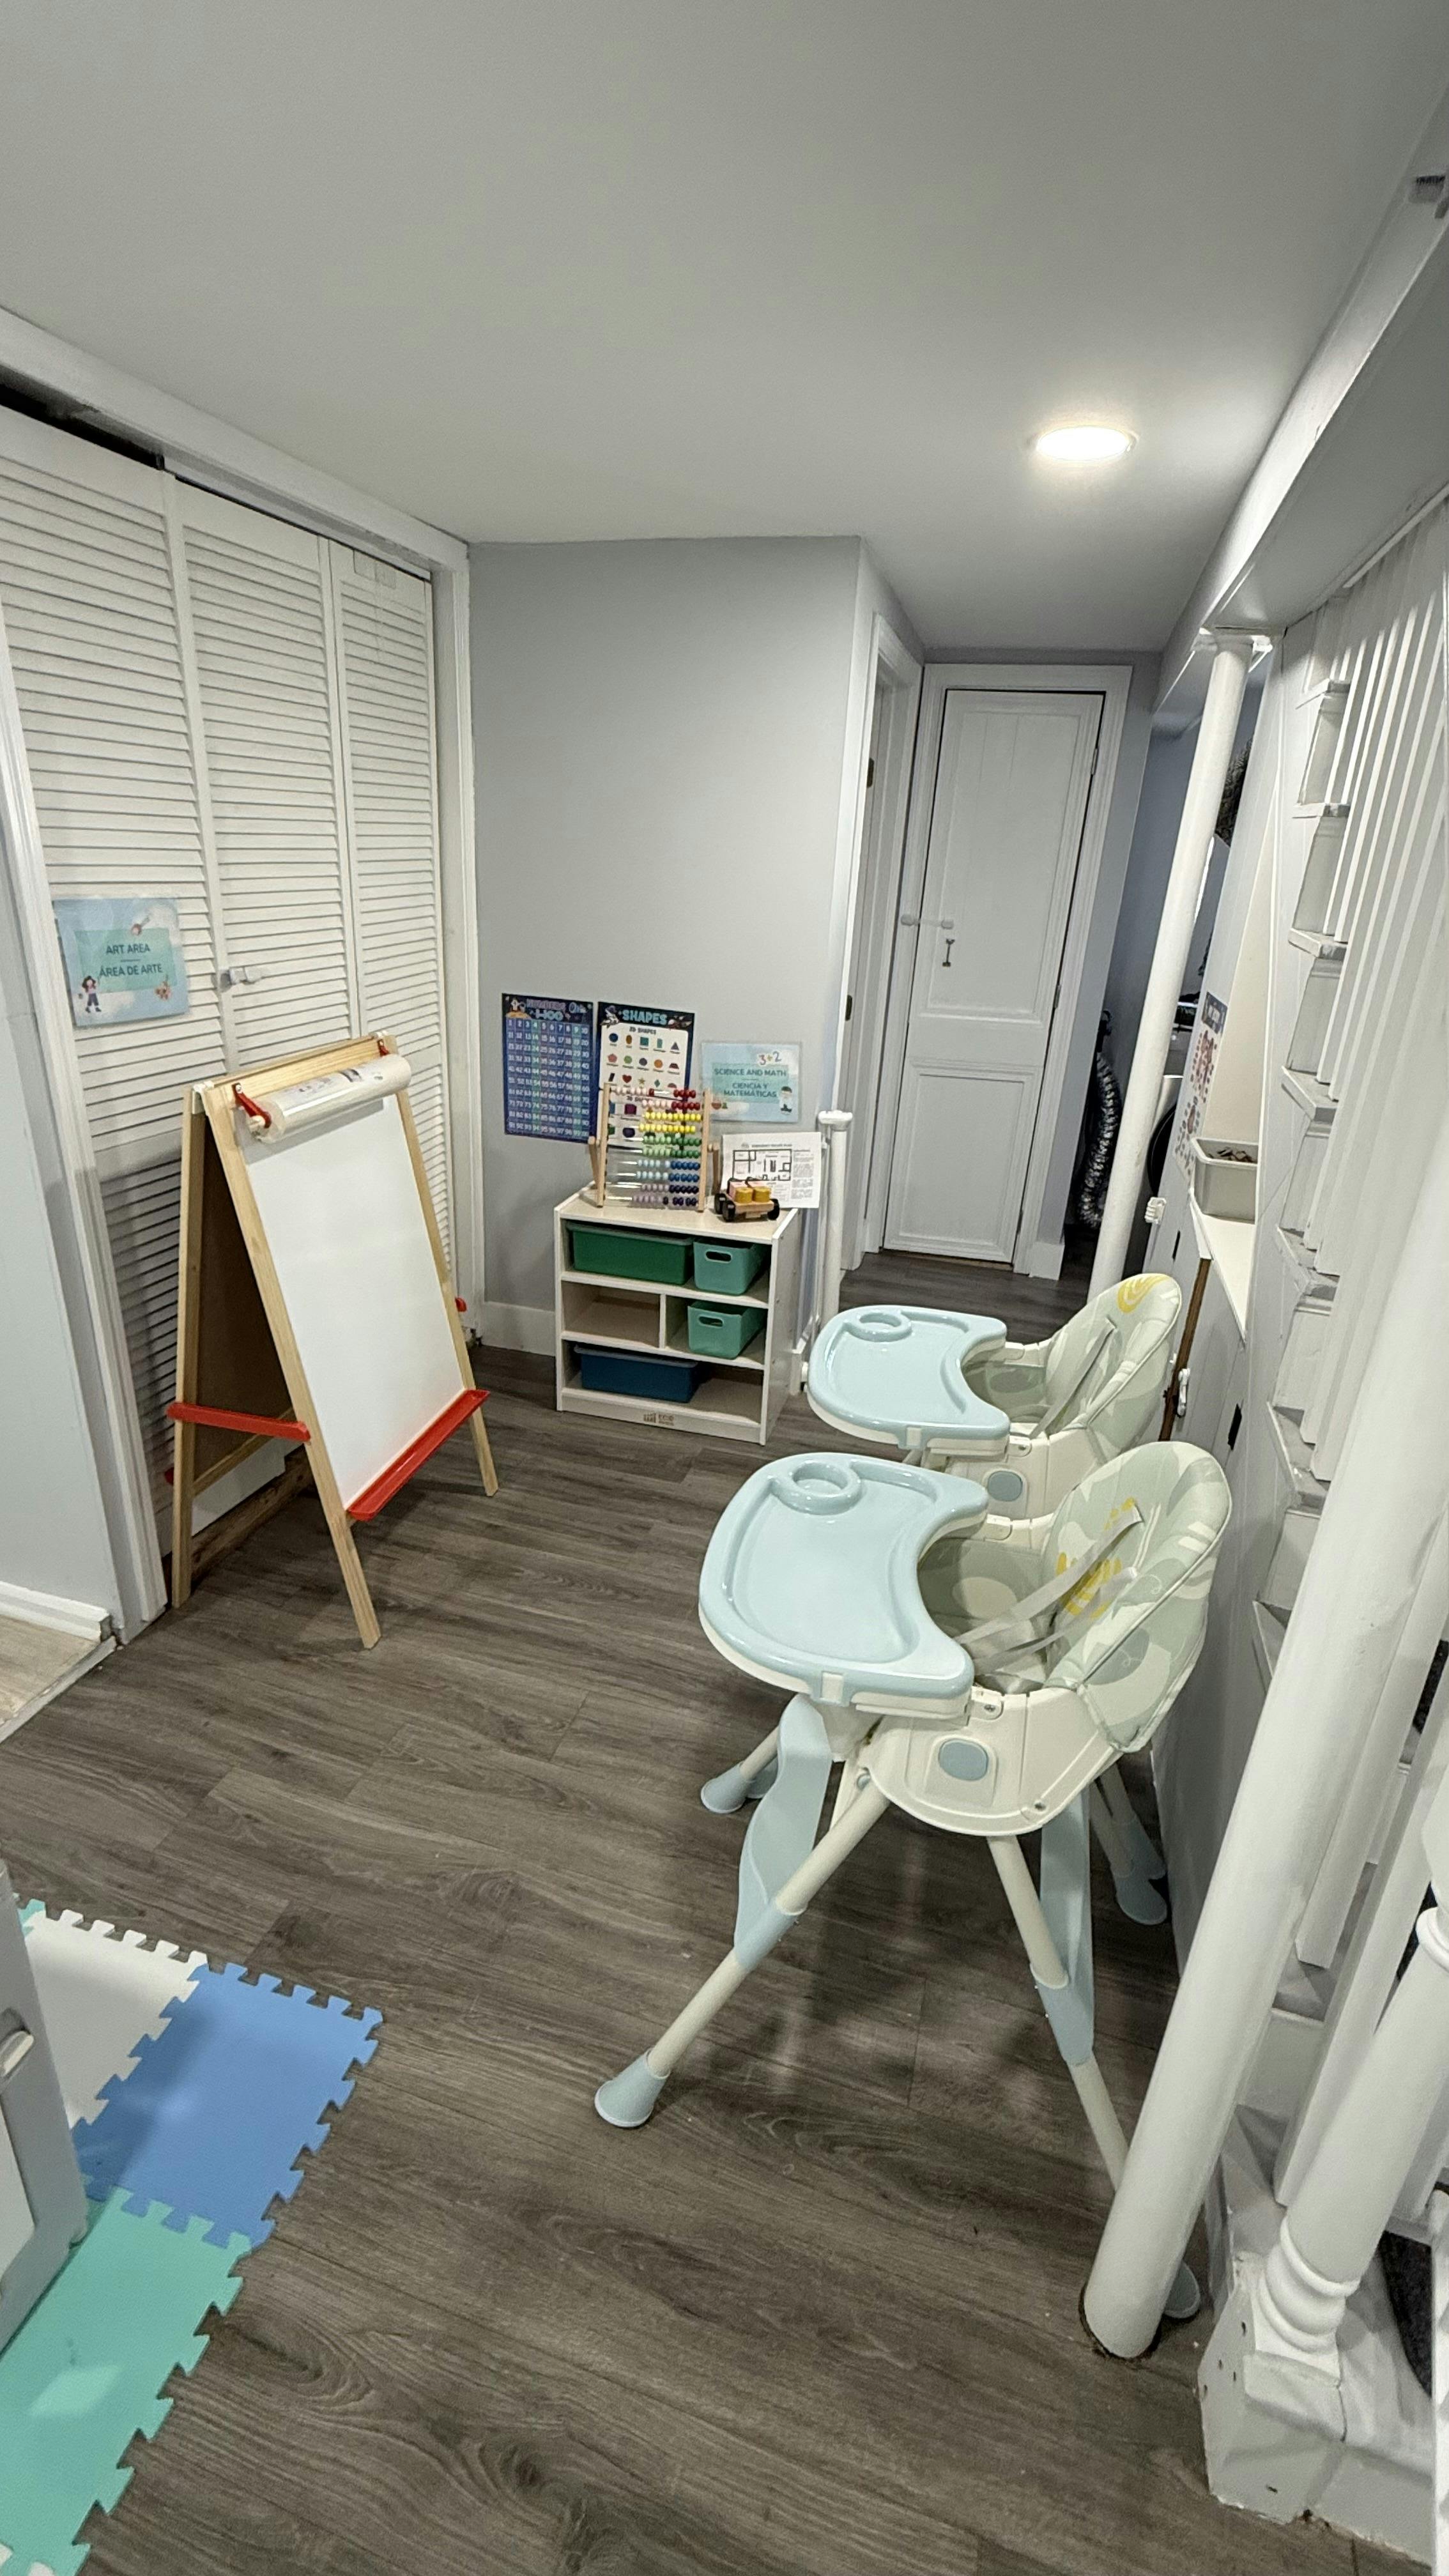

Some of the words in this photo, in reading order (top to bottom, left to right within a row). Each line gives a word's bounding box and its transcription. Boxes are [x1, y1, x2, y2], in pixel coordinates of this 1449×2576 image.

[106, 944, 125, 954] ART
[127, 943, 150, 954] AREA
[126, 965, 139, 976] DE
[141, 963, 163, 975] ARTE
[622, 1009, 668, 1025] SHAPES
